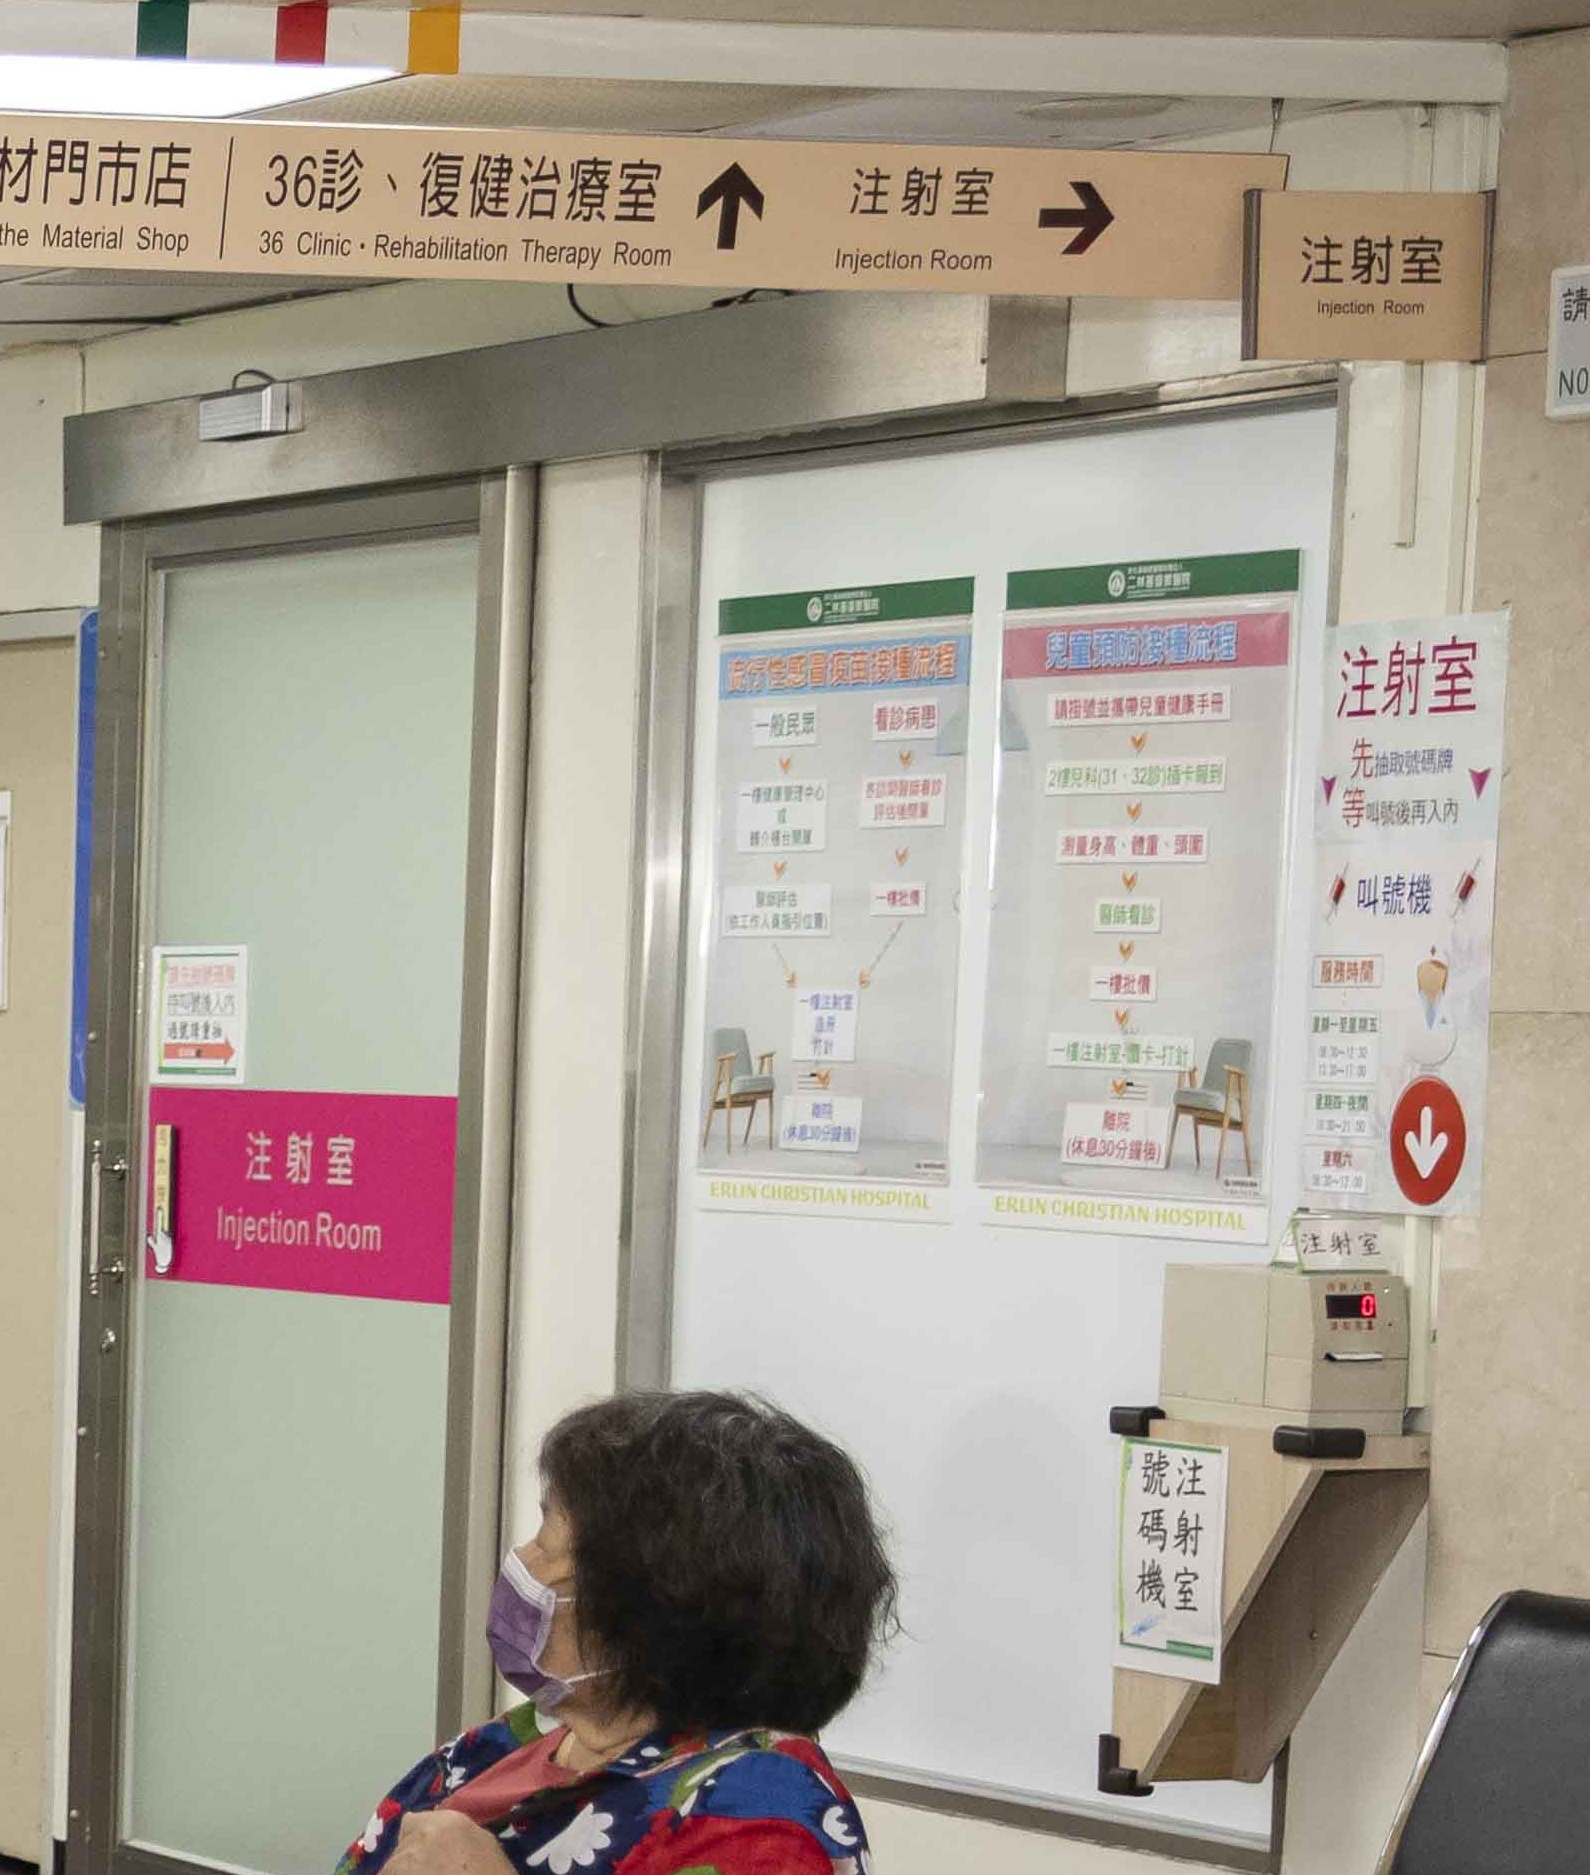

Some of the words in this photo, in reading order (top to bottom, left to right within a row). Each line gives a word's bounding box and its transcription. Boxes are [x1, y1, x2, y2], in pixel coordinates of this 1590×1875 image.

[264, 149, 663, 227] 36診、復健治療室
[849, 165, 995, 218] 注射室
[42, 222, 124, 251] Material
[136, 224, 190, 256] Shop
[259, 231, 284, 256] 36
[374, 233, 507, 262] Rehabilitation
[521, 238, 600, 270] Therapy
[614, 239, 671, 267] Room
[835, 247, 922, 273] Injection
[929, 248, 993, 272] Room
[1299, 232, 1445, 287] 注射室
[1316, 297, 1376, 317] Injection
[1383, 298, 1426, 316] Room
[1335, 634, 1478, 719] 注射室
[1350, 736, 1454, 782] 先抽取號碼牌
[1357, 873, 1433, 916] 叫號機
[245, 1132, 356, 1186] 注射室
[710, 1181, 759, 1200] ERLIN
[761, 1185, 847, 1205] CHRISTIAN
[851, 1189, 930, 1210] HOSPITAL
[994, 1195, 1047, 1215] ERLIN
[1051, 1199, 1150, 1223] CHRISTIAN
[1154, 1205, 1247, 1231] HOSPITAL
[217, 1207, 309, 1250] Injection
[315, 1211, 382, 1251] Room
[1301, 1231, 1380, 1256] 注射室
[1360, 1295, 1375, 1317] 0
[1136, 1451, 1170, 1609] 號碼機
[1174, 1456, 1207, 1613] 注射室
